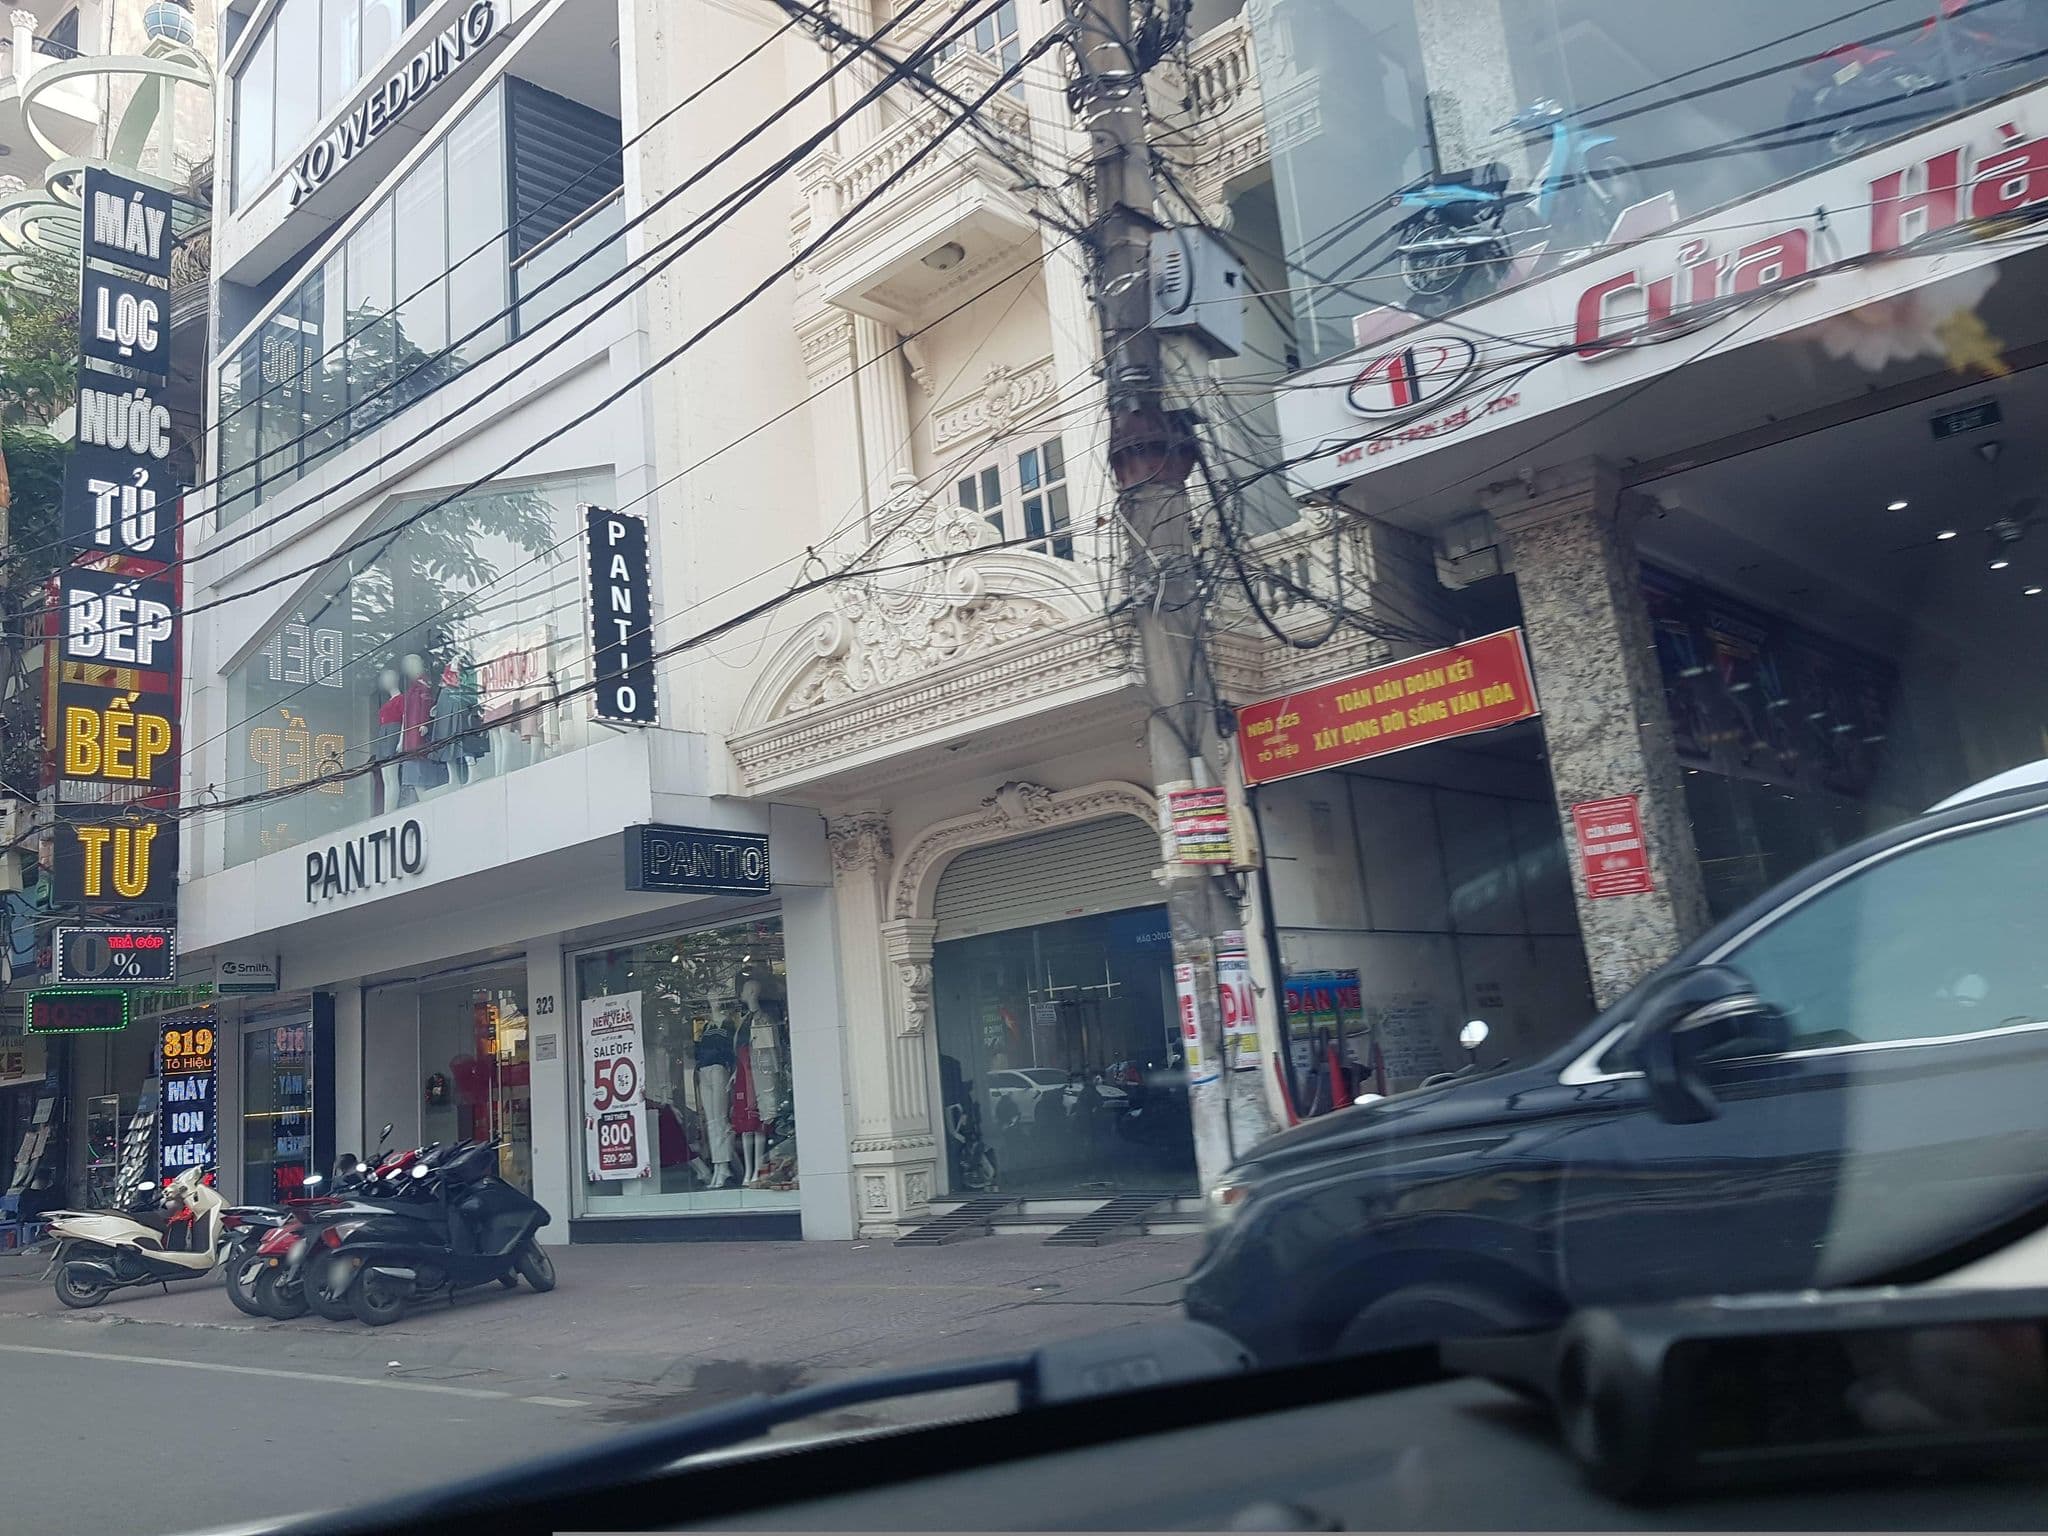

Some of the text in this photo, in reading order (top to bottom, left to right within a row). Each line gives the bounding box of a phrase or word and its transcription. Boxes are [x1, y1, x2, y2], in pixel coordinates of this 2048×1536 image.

[94, 191, 166, 260] MÁY
[96, 287, 159, 356] LỌC
[1575, 226, 1809, 362] Cửa
[81, 387, 171, 460] NƯỚC
[87, 467, 157, 551] TỦ
[67, 579, 173, 665] BẾP
[607, 519, 638, 714] PANTIO
[1312, 681, 1515, 751] XÂY DỰNG ĐỜI SỐNG VĂN HÓA
[1336, 656, 1474, 714] TOÀN DÂN ĐOÀN KẾT
[64, 692, 172, 781] BẾP
[305, 818, 427, 905] PANTIO
[650, 838, 764, 880] PANTIO
[107, 934, 164, 949] TRẢ GÓP
[536, 996, 554, 1016] 323
[164, 1028, 213, 1057] 319
[166, 1057, 212, 1070] Tô Hiệu
[594, 1042, 633, 1058] SALE OFF
[168, 1076, 209, 1102] MÁY
[594, 1057, 637, 1111] 50
[172, 1111, 205, 1134] ION
